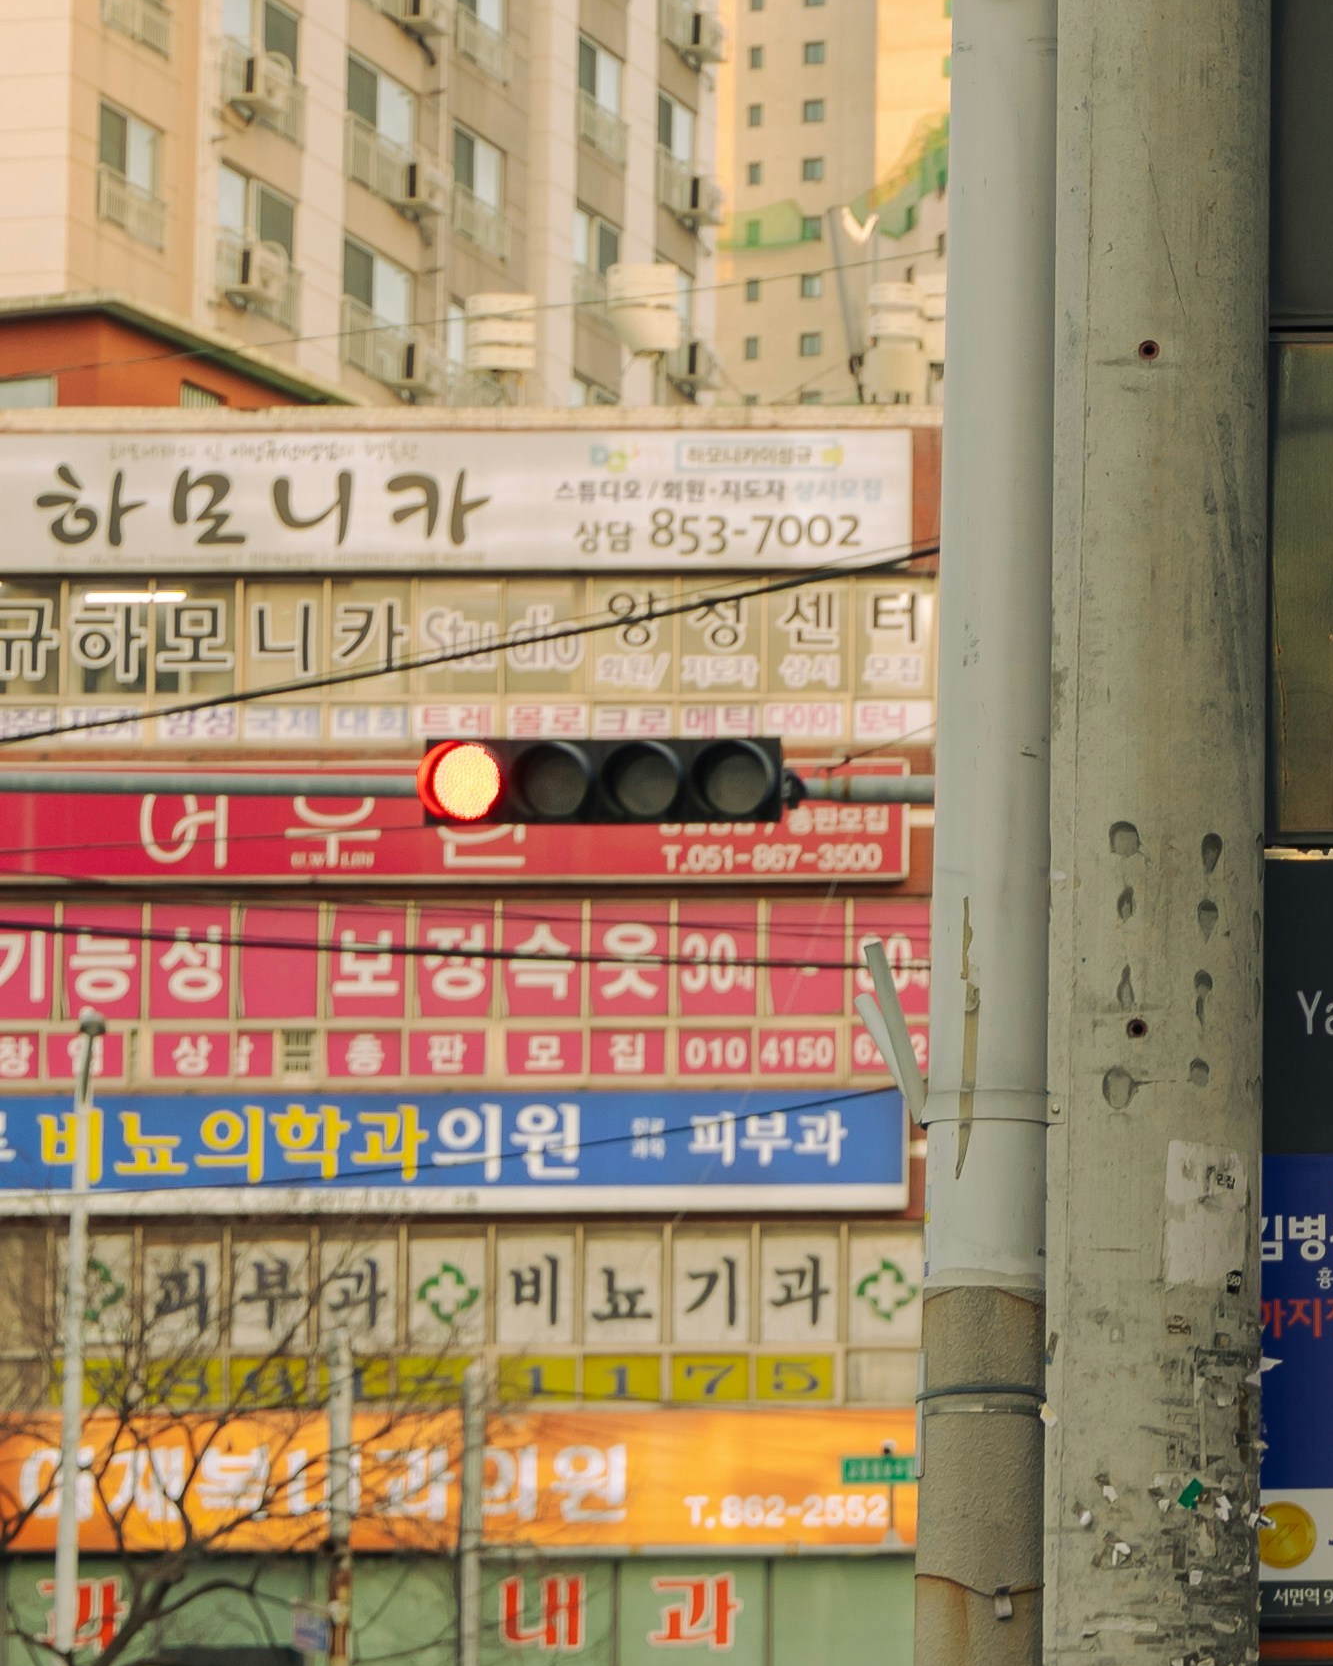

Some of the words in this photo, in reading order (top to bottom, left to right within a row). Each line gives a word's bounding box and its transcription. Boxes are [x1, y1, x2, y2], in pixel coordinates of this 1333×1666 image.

[36, 463, 491, 547] 하모니카
[574, 519, 633, 554] 상담
[649, 507, 861, 556] 853-7002
[687, 1110, 848, 1167] 피부과
[509, 1253, 831, 1327] 비뇨기과
[683, 1493, 888, 1530] T.862-2552
